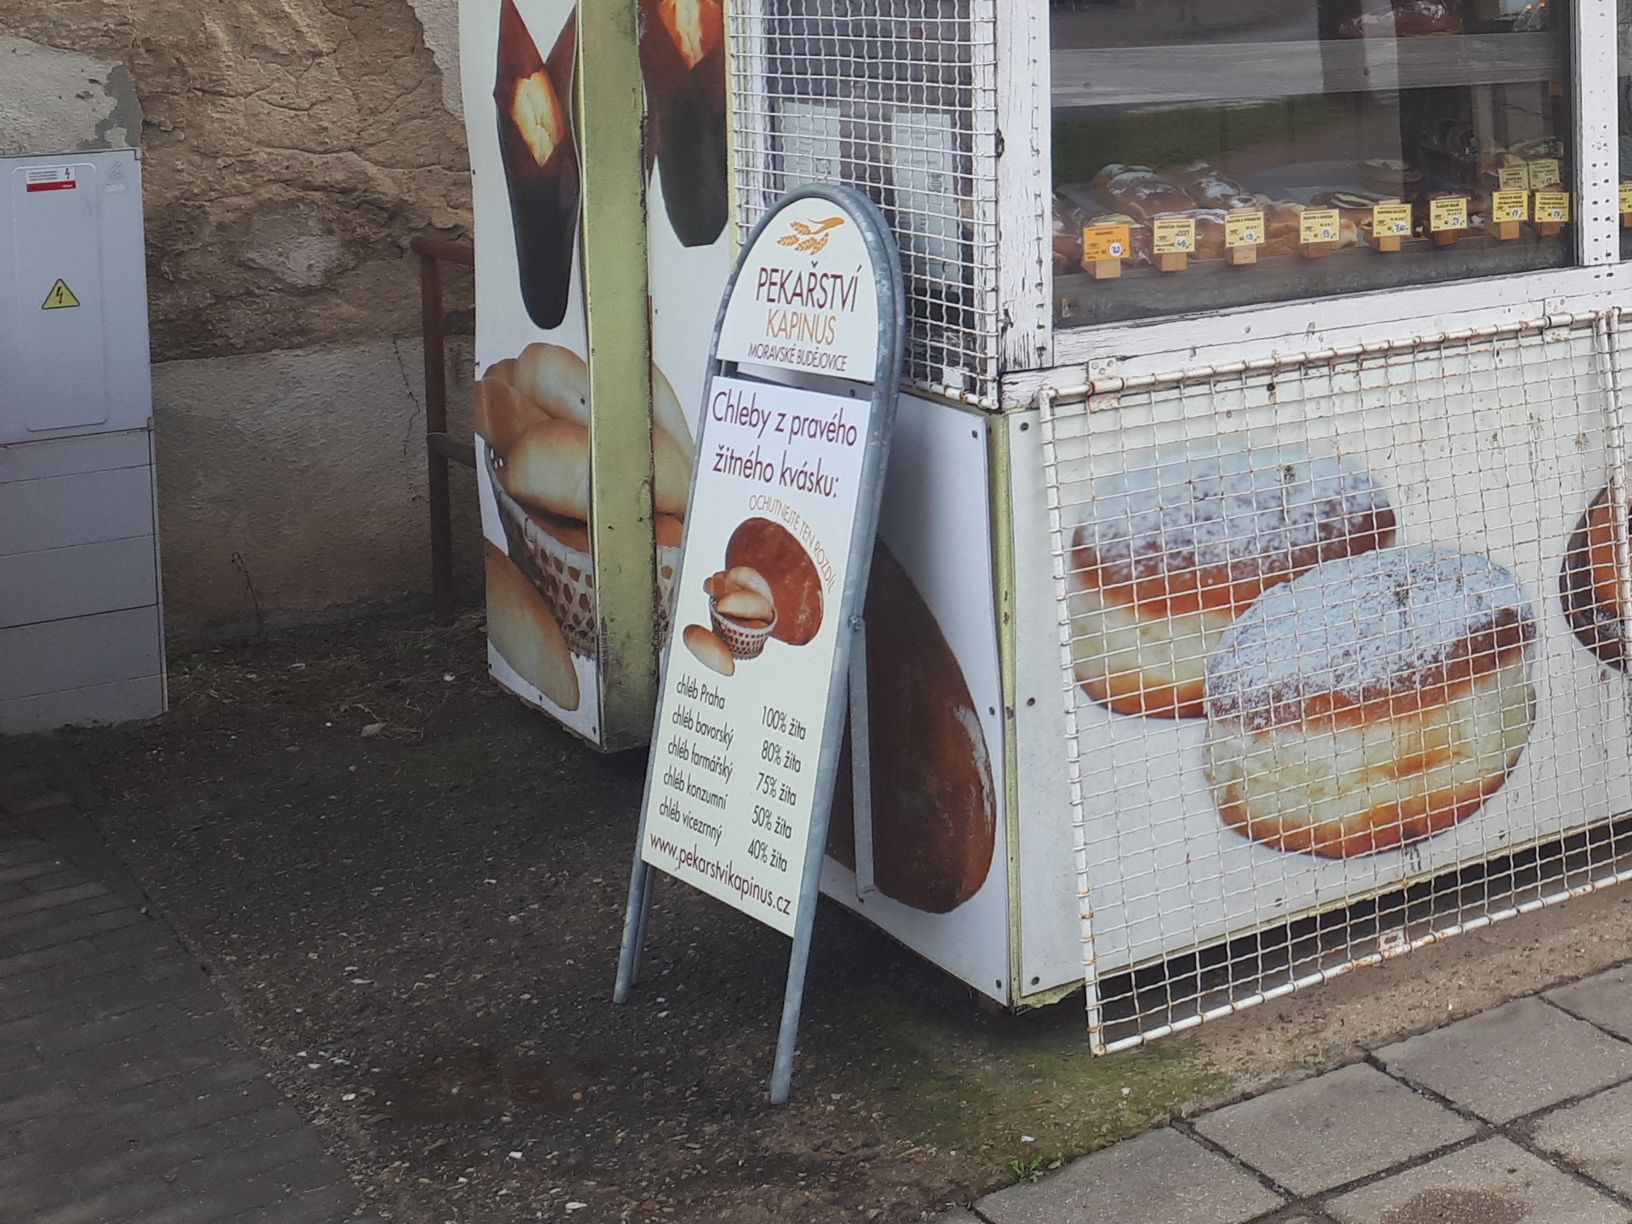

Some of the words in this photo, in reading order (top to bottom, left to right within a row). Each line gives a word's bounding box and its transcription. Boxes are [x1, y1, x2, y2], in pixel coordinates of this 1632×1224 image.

[756, 261, 862, 313] PEKAŘSTVÍ
[747, 343, 796, 364] MORAVSKÉ
[796, 347, 848, 372] BUDĚJOVICE
[765, 309, 837, 346] KAPINUS
[711, 390, 772, 438] Chleby
[774, 411, 785, 433] z
[788, 407, 858, 447] pravého
[712, 444, 774, 484] žitného
[779, 450, 839, 499] kvásku:
[748, 494, 801, 532] OCHUTNEJTE
[799, 520, 816, 548] TEN
[812, 540, 837, 594] ROZDÍL
[672, 704, 694, 732] chléb
[695, 714, 734, 751] bavorský
[761, 740, 782, 765] 80%
[785, 746, 801, 774] žita
[677, 674, 698, 701] chléb
[700, 684, 726, 710] Praha
[761, 705, 786, 733] 100%
[789, 712, 806, 740] žita
[663, 766, 685, 793] chléb
[685, 774, 728, 810] konzumní
[751, 805, 772, 831] 50%
[775, 812, 792, 839] žita
[668, 735, 690, 763] chléb
[691, 740, 734, 784] farmářský
[756, 772, 778, 797] 75%
[779, 778, 797, 806] žita
[659, 797, 681, 823] chléb
[748, 838, 768, 864] 40%
[770, 845, 788, 872] žita
[649, 833, 792, 917] www.pekarstvikapinus.cz
